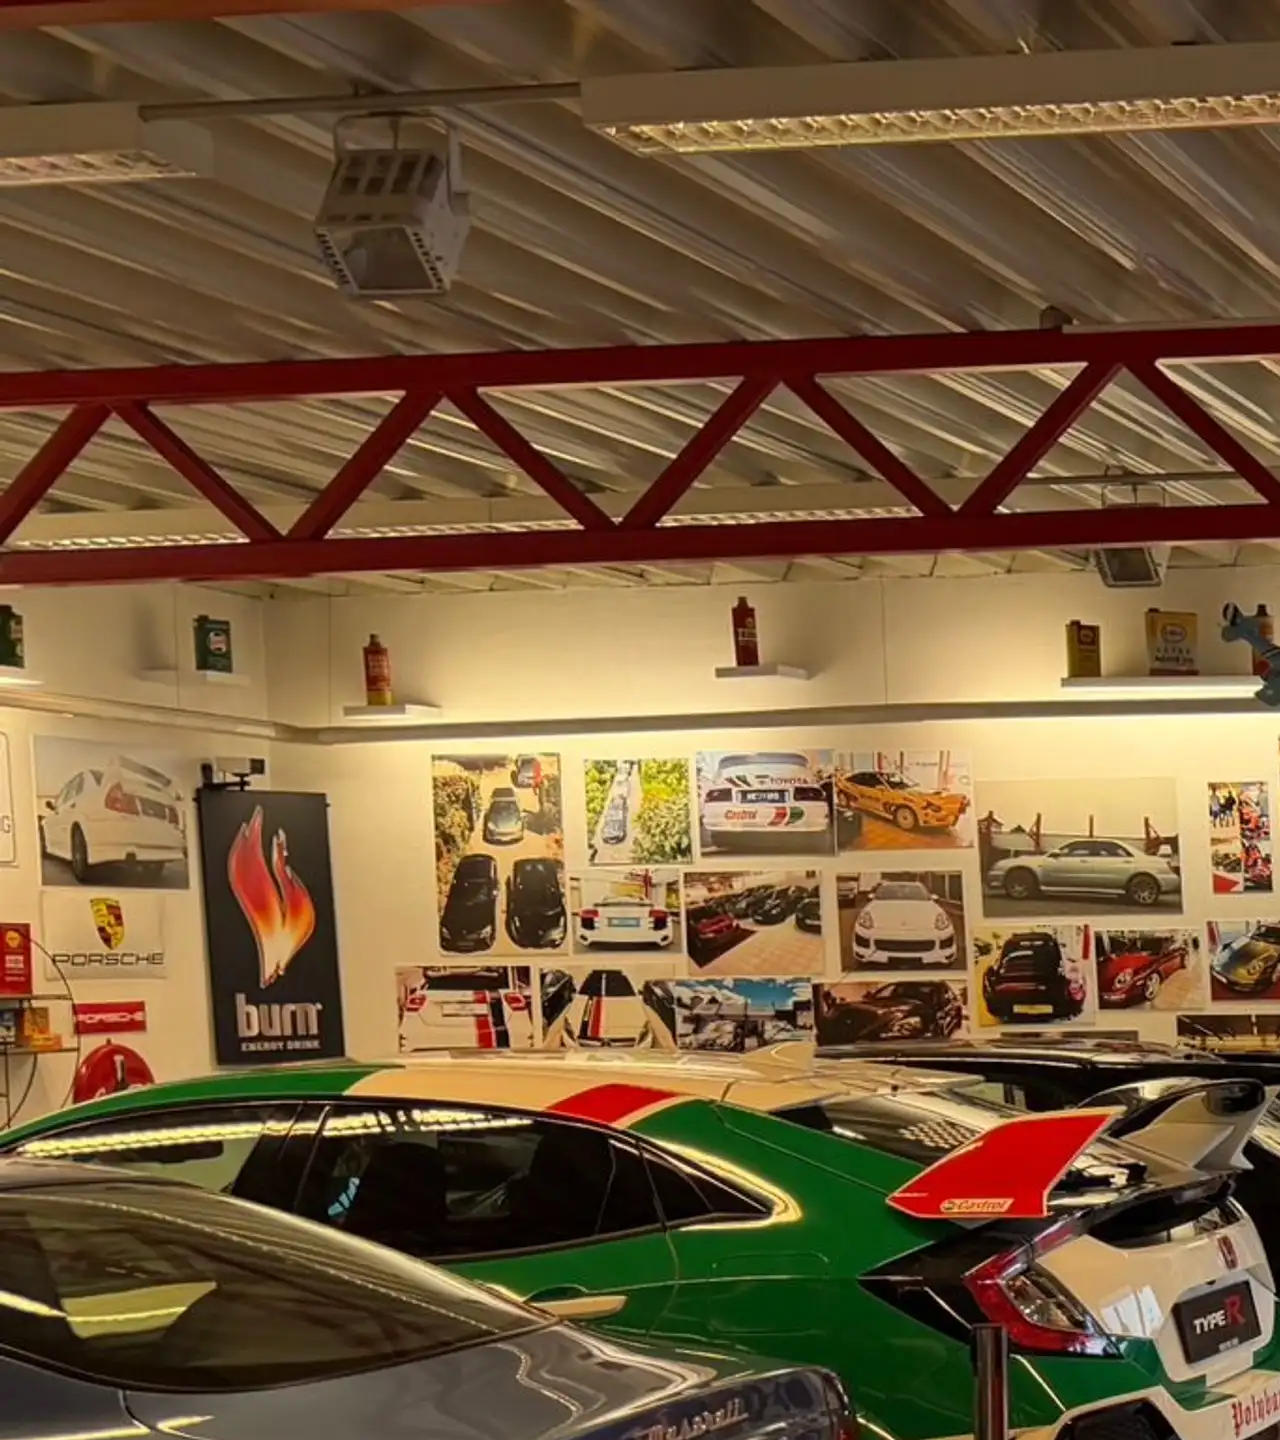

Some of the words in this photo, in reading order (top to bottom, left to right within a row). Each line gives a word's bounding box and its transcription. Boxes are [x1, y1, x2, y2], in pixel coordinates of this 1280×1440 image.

[52, 952, 164, 967] PORSCHE
[235, 992, 319, 1038] burn
[1193, 1309, 1226, 1335] TYPE
[1225, 1295, 1247, 1325] R
